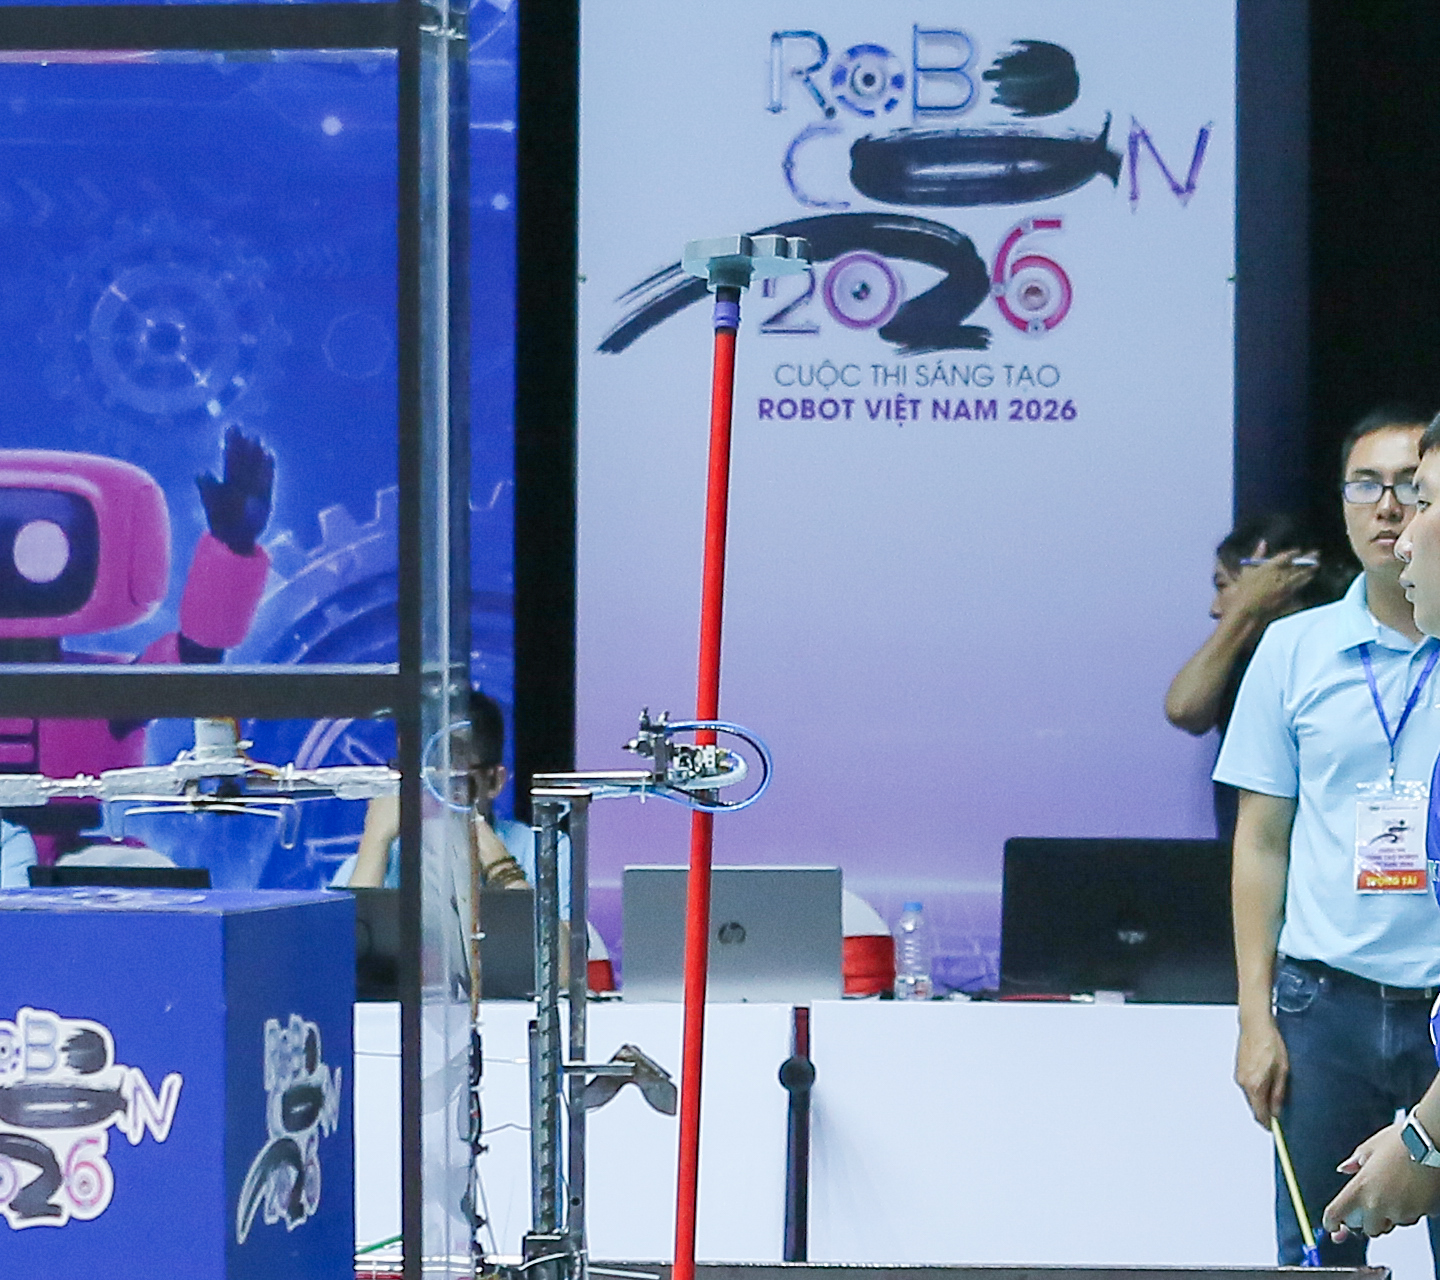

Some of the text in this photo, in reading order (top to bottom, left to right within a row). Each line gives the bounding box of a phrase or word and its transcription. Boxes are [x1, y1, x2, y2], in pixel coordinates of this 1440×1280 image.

[774, 359, 1060, 393] CUỘC THI SÁNG TẠO
[759, 392, 1078, 428] ROBOT VIỆT NAM 2026
